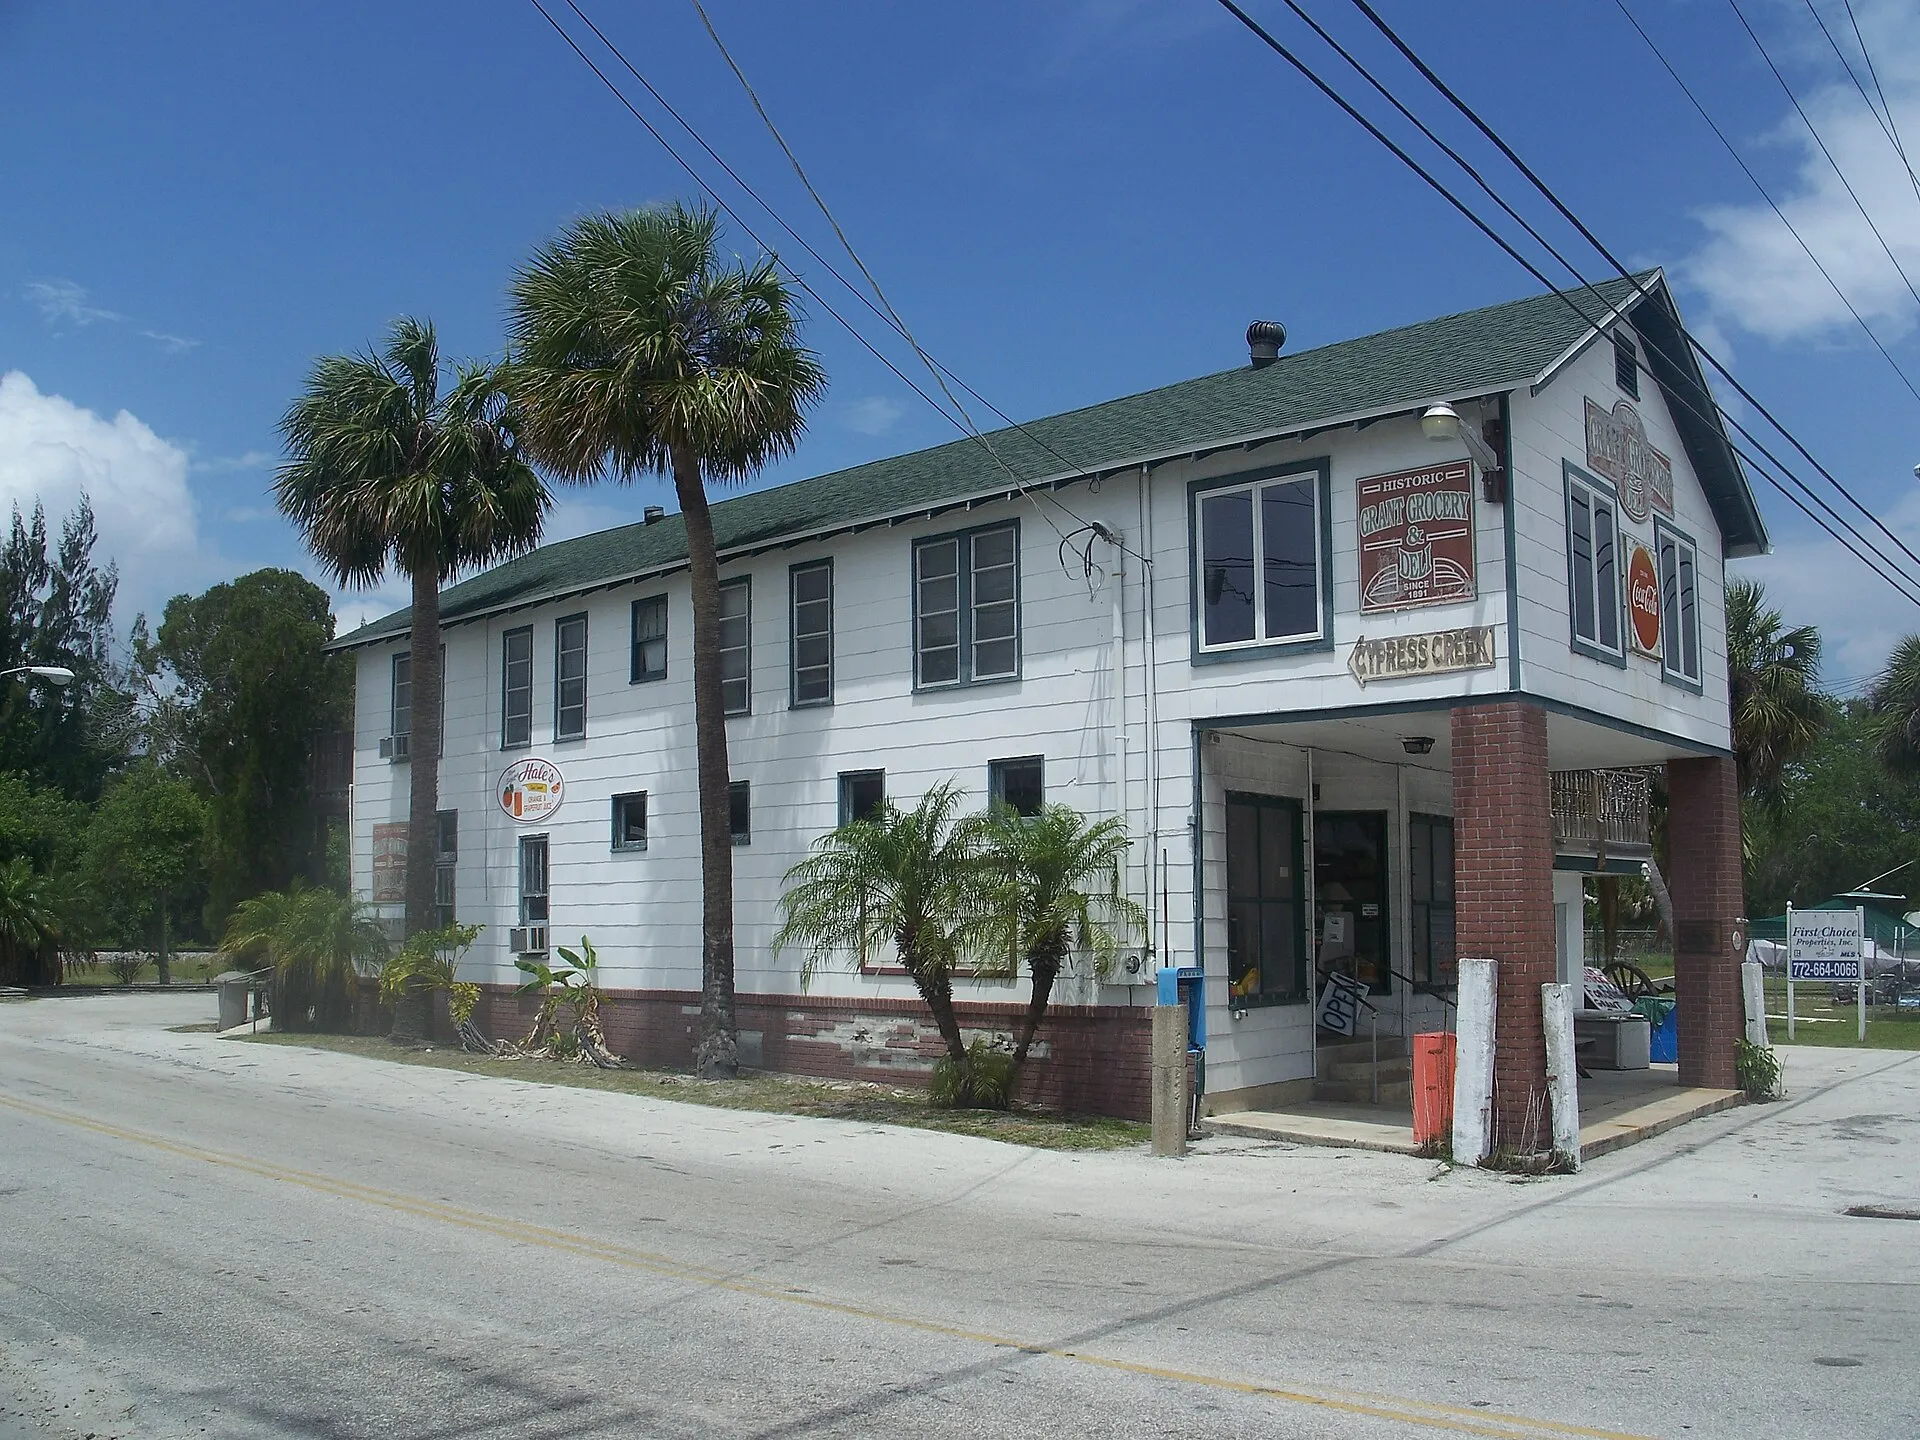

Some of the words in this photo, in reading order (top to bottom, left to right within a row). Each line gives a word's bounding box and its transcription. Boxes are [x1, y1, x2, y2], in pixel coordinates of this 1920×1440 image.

[1382, 472, 1444, 492] HISTORIC
[1360, 496, 1405, 538] GRANT
[1406, 490, 1470, 524] GROCERY
[1406, 525, 1425, 546] &
[1398, 542, 1432, 580] DELI
[1403, 580, 1430, 591] SINCE
[1407, 589, 1428, 599] 1891
[1354, 637, 1428, 675] CYPRESS
[1431, 629, 1491, 667] CREEK
[518, 763, 554, 783] Hale's
[1792, 926, 1819, 937] First
[1821, 926, 1858, 937] Choice
[1796, 938, 1836, 947] Properties,
[1792, 962, 1858, 977] 772-664-0066
[1321, 973, 1366, 1030] OPEN
